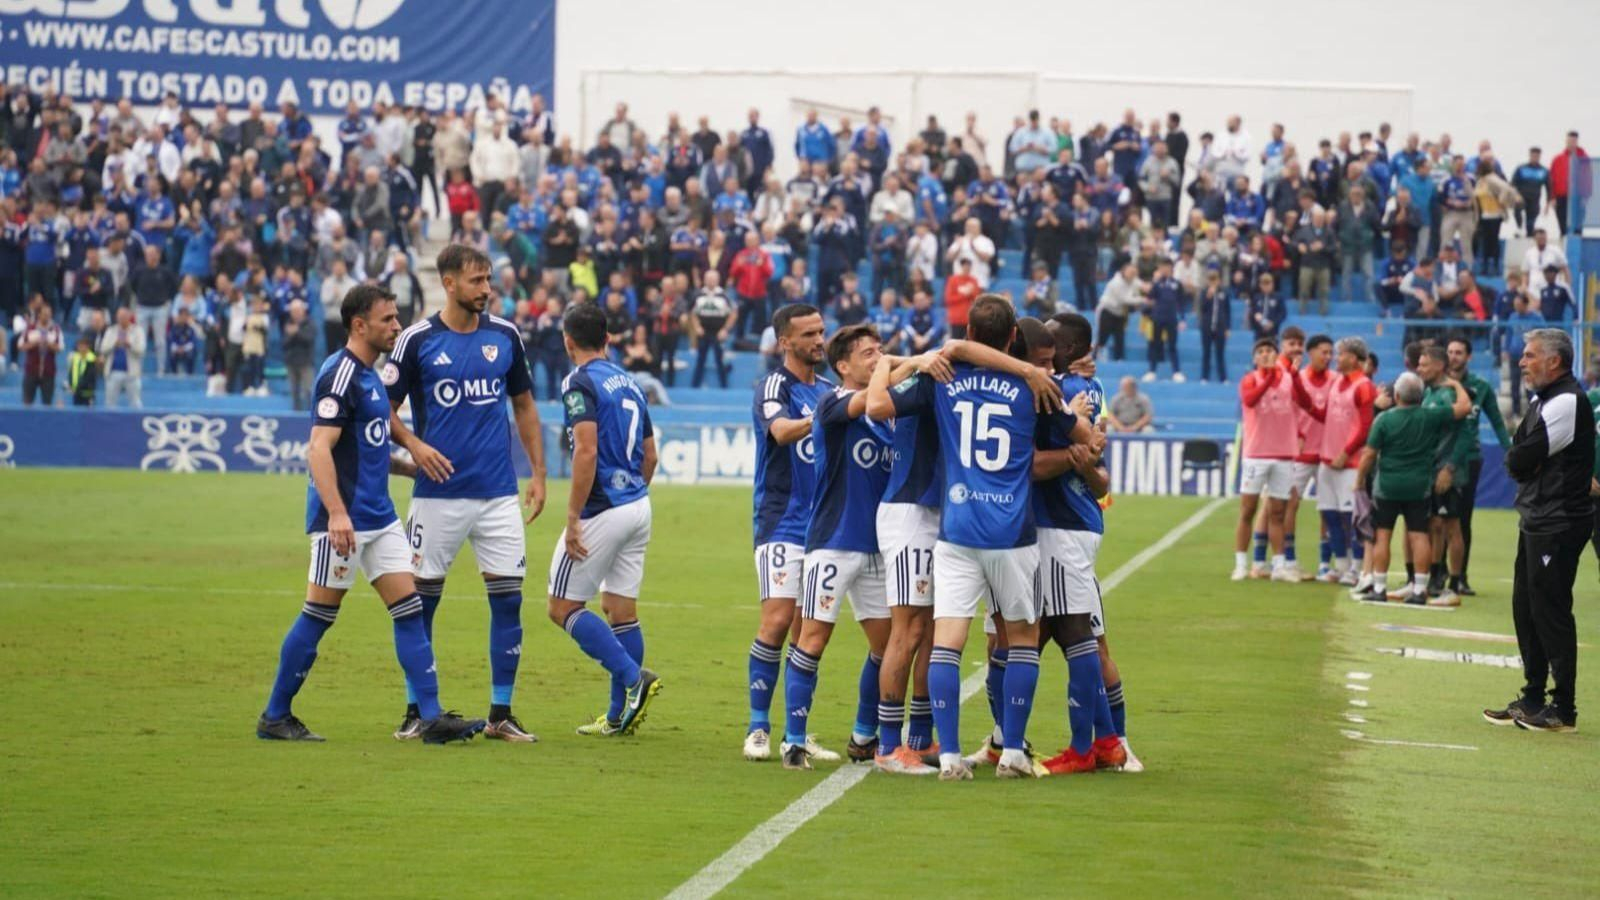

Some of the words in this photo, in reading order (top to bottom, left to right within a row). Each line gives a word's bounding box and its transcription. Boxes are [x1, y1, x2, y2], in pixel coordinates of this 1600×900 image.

[24, 21, 400, 62] WWW.CAFESCASTULO.COM
[0, 59, 108, 97] ECIÉN
[117, 70, 268, 104] TOSTADO
[276, 77, 300, 106] A
[307, 78, 396, 109] TODA
[403, 77, 534, 113] ESPAÑA
[464, 378, 502, 398] MLC
[946, 376, 978, 397] JAVI
[980, 376, 1020, 402] LARA
[622, 398, 640, 461] 7
[952, 400, 1012, 472] 15
[772, 543, 786, 569] 8
[912, 547, 934, 576] 17
[822, 563, 838, 592] 2
